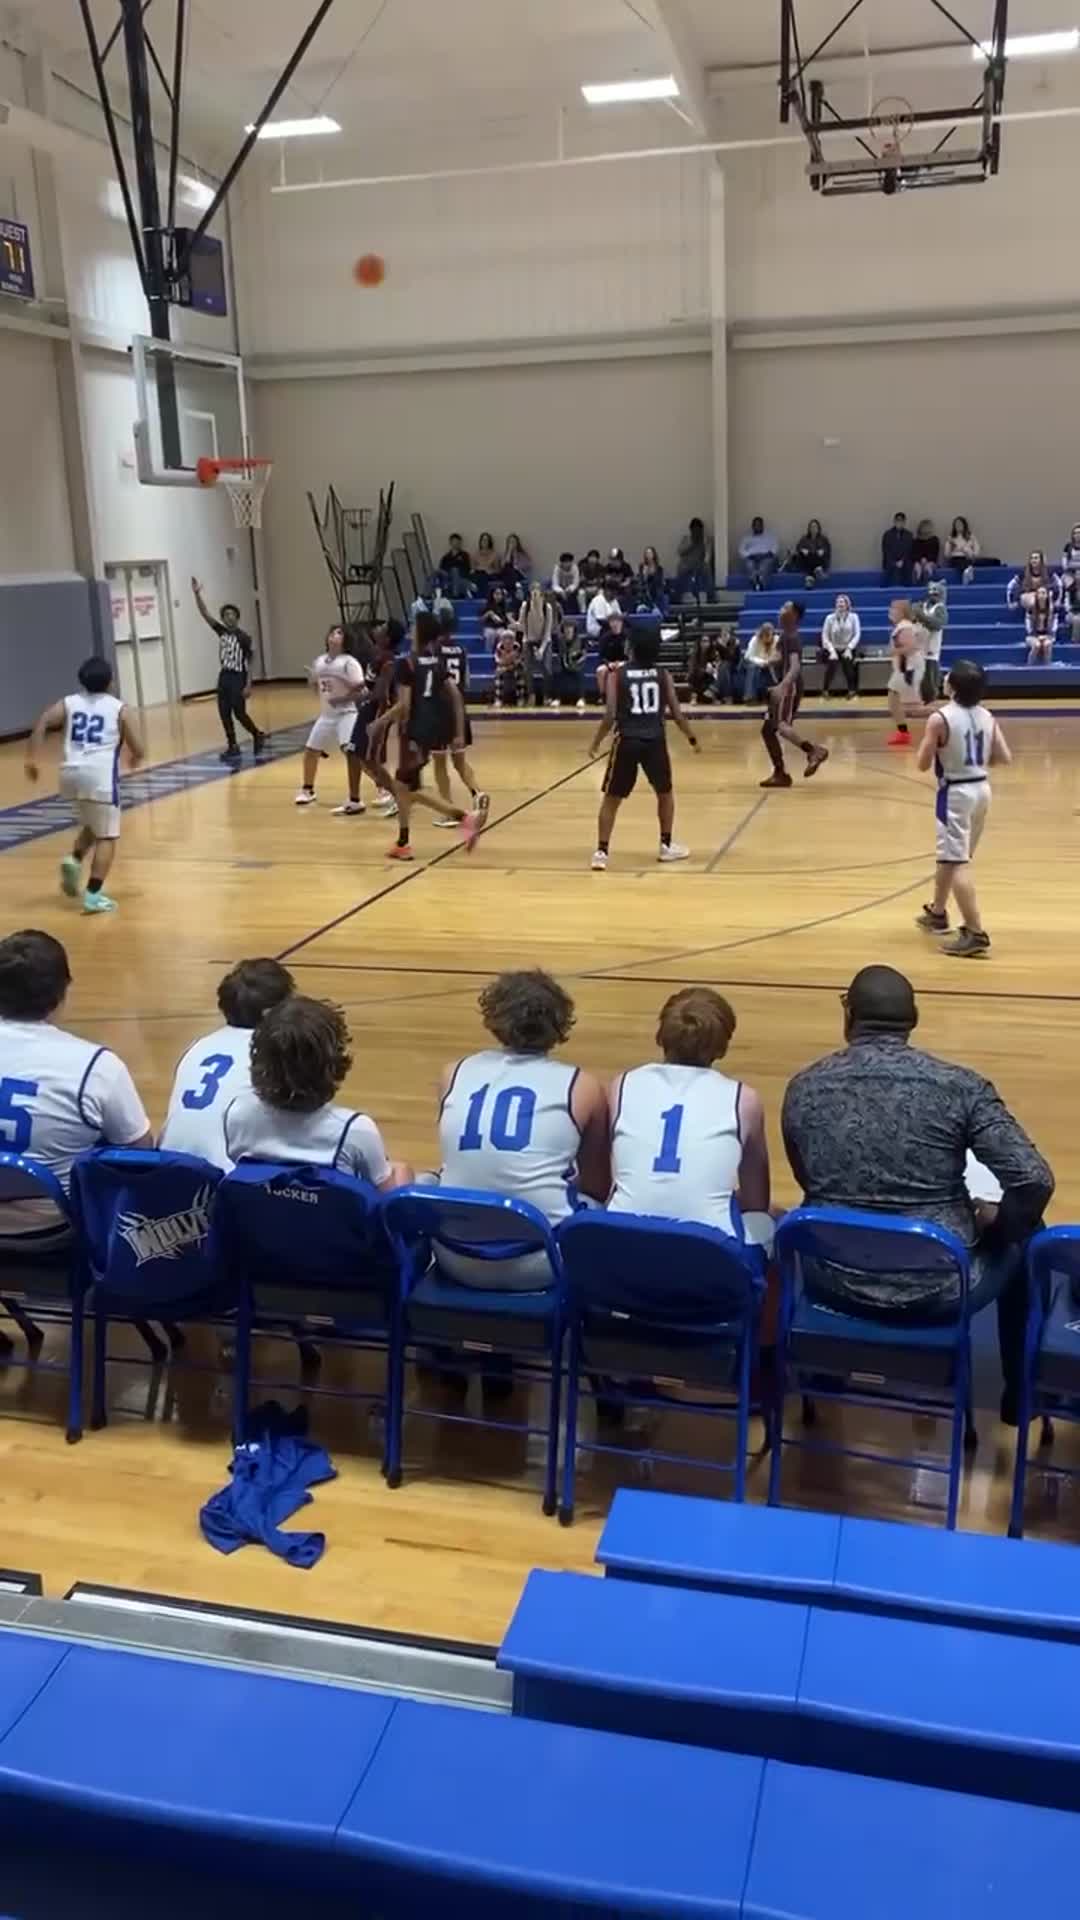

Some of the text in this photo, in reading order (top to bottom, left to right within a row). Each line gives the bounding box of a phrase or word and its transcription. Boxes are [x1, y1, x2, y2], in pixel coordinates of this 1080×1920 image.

[422, 670, 434, 698] 1
[630, 681, 660, 714] 10
[71, 711, 105, 744] 22
[964, 728, 984, 767] 11
[182, 1053, 234, 1111] 3
[458, 1082, 538, 1152] 10
[652, 1103, 685, 1174] 1
